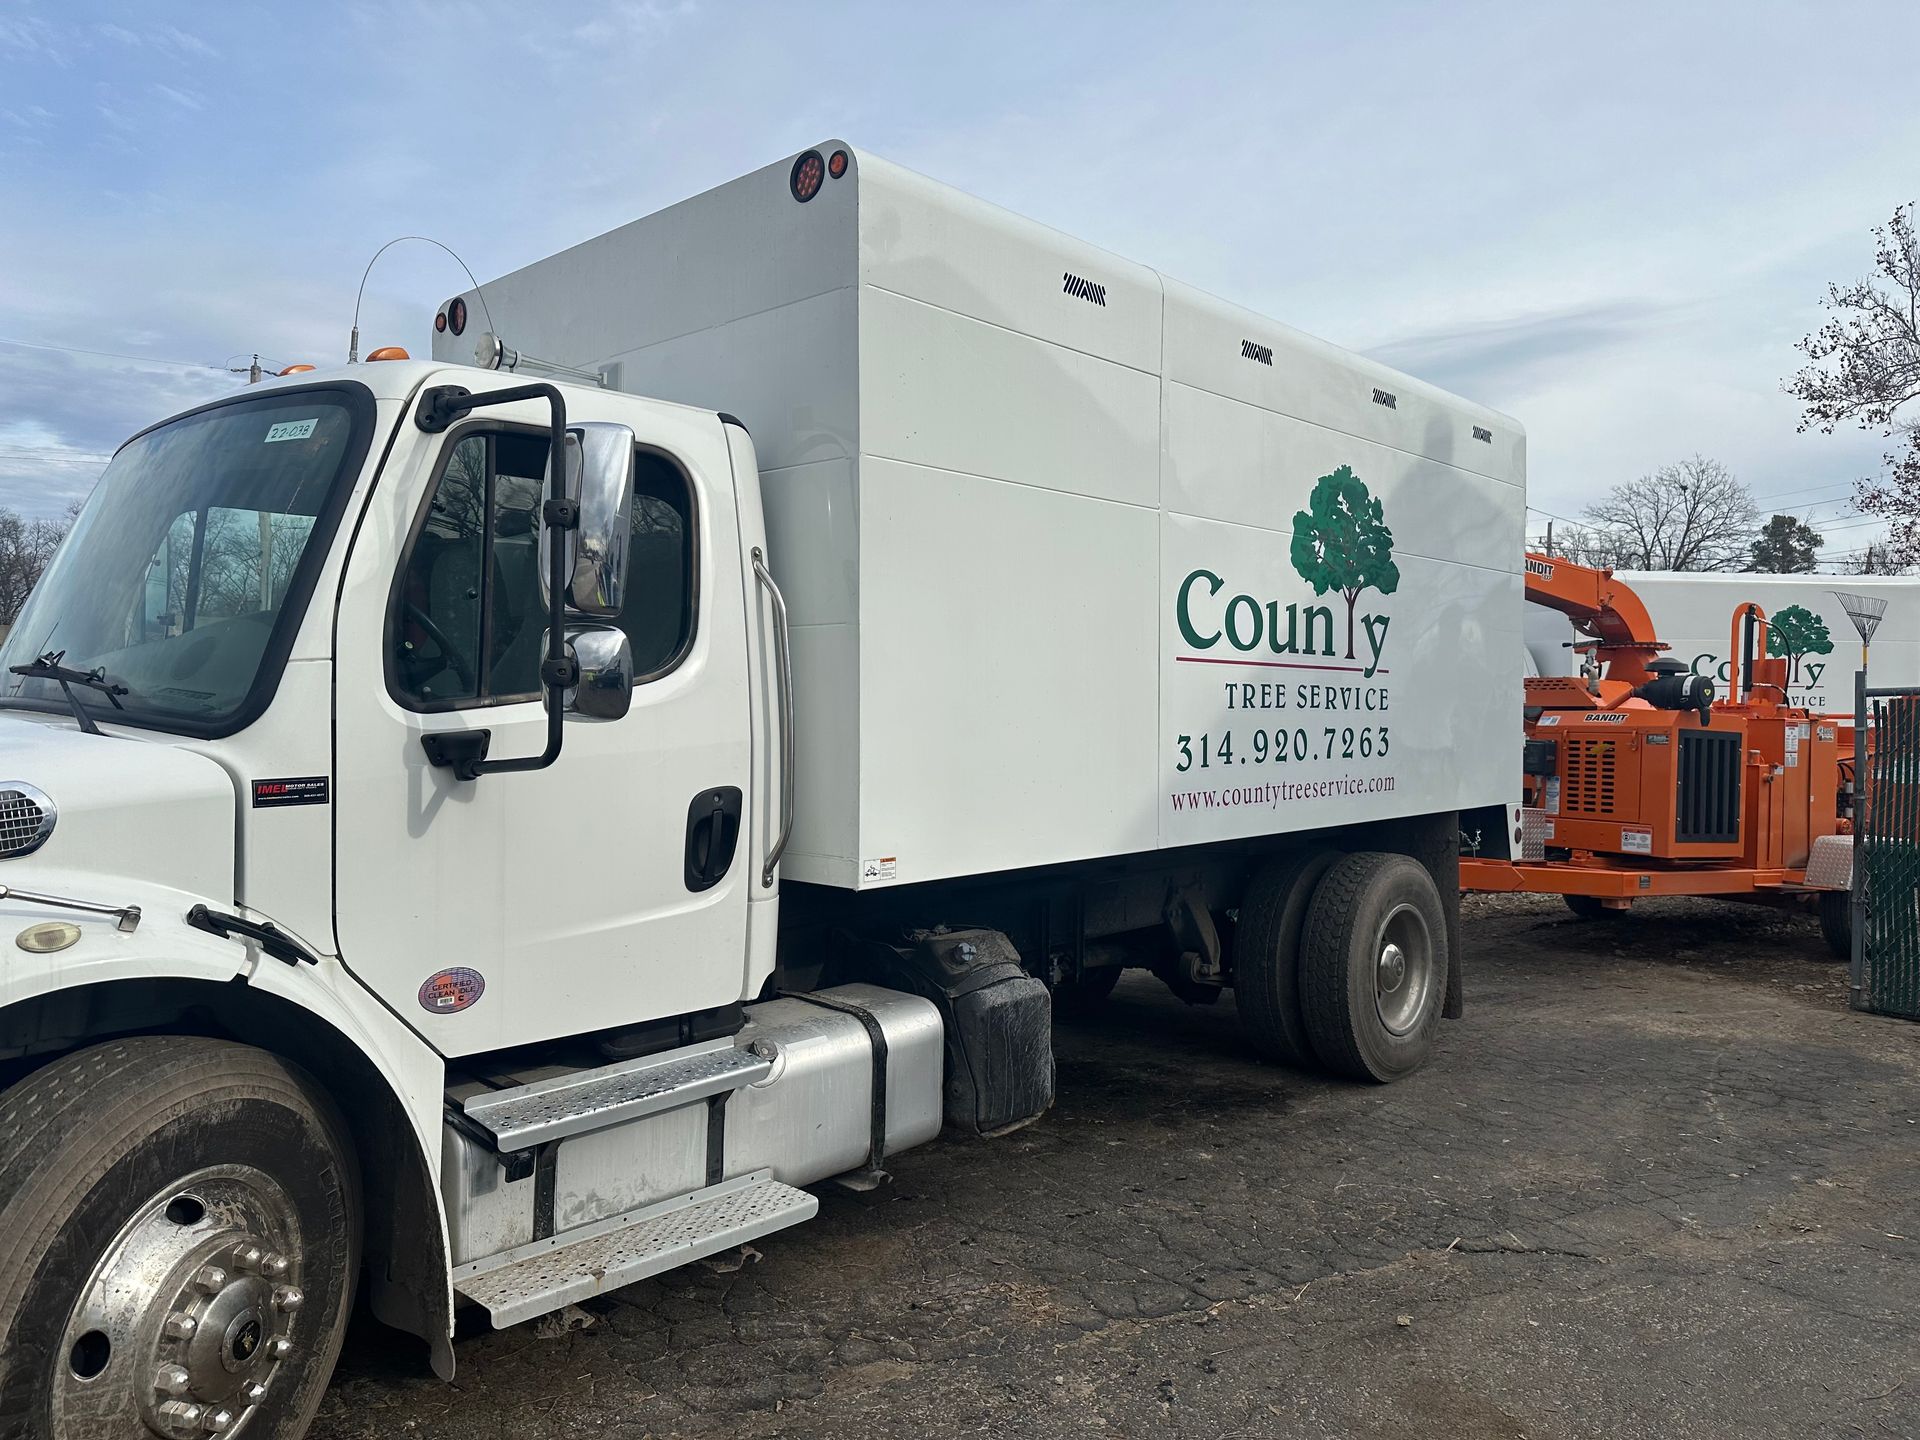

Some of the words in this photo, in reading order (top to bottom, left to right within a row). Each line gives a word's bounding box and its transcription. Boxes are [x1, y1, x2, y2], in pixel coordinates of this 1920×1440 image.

[1525, 559, 1554, 575] ANDIT
[1176, 569, 1391, 679] County
[1225, 682, 1287, 709] TREE
[1296, 684, 1390, 711] SERVICE
[1790, 696, 1826, 707] VICE
[1175, 726, 1390, 773] 314.920.7263
[1171, 774, 1396, 811] www.countytreeservice.com
[428, 989, 455, 999] CLEAN
[432, 980, 472, 991] CERTIFIED
